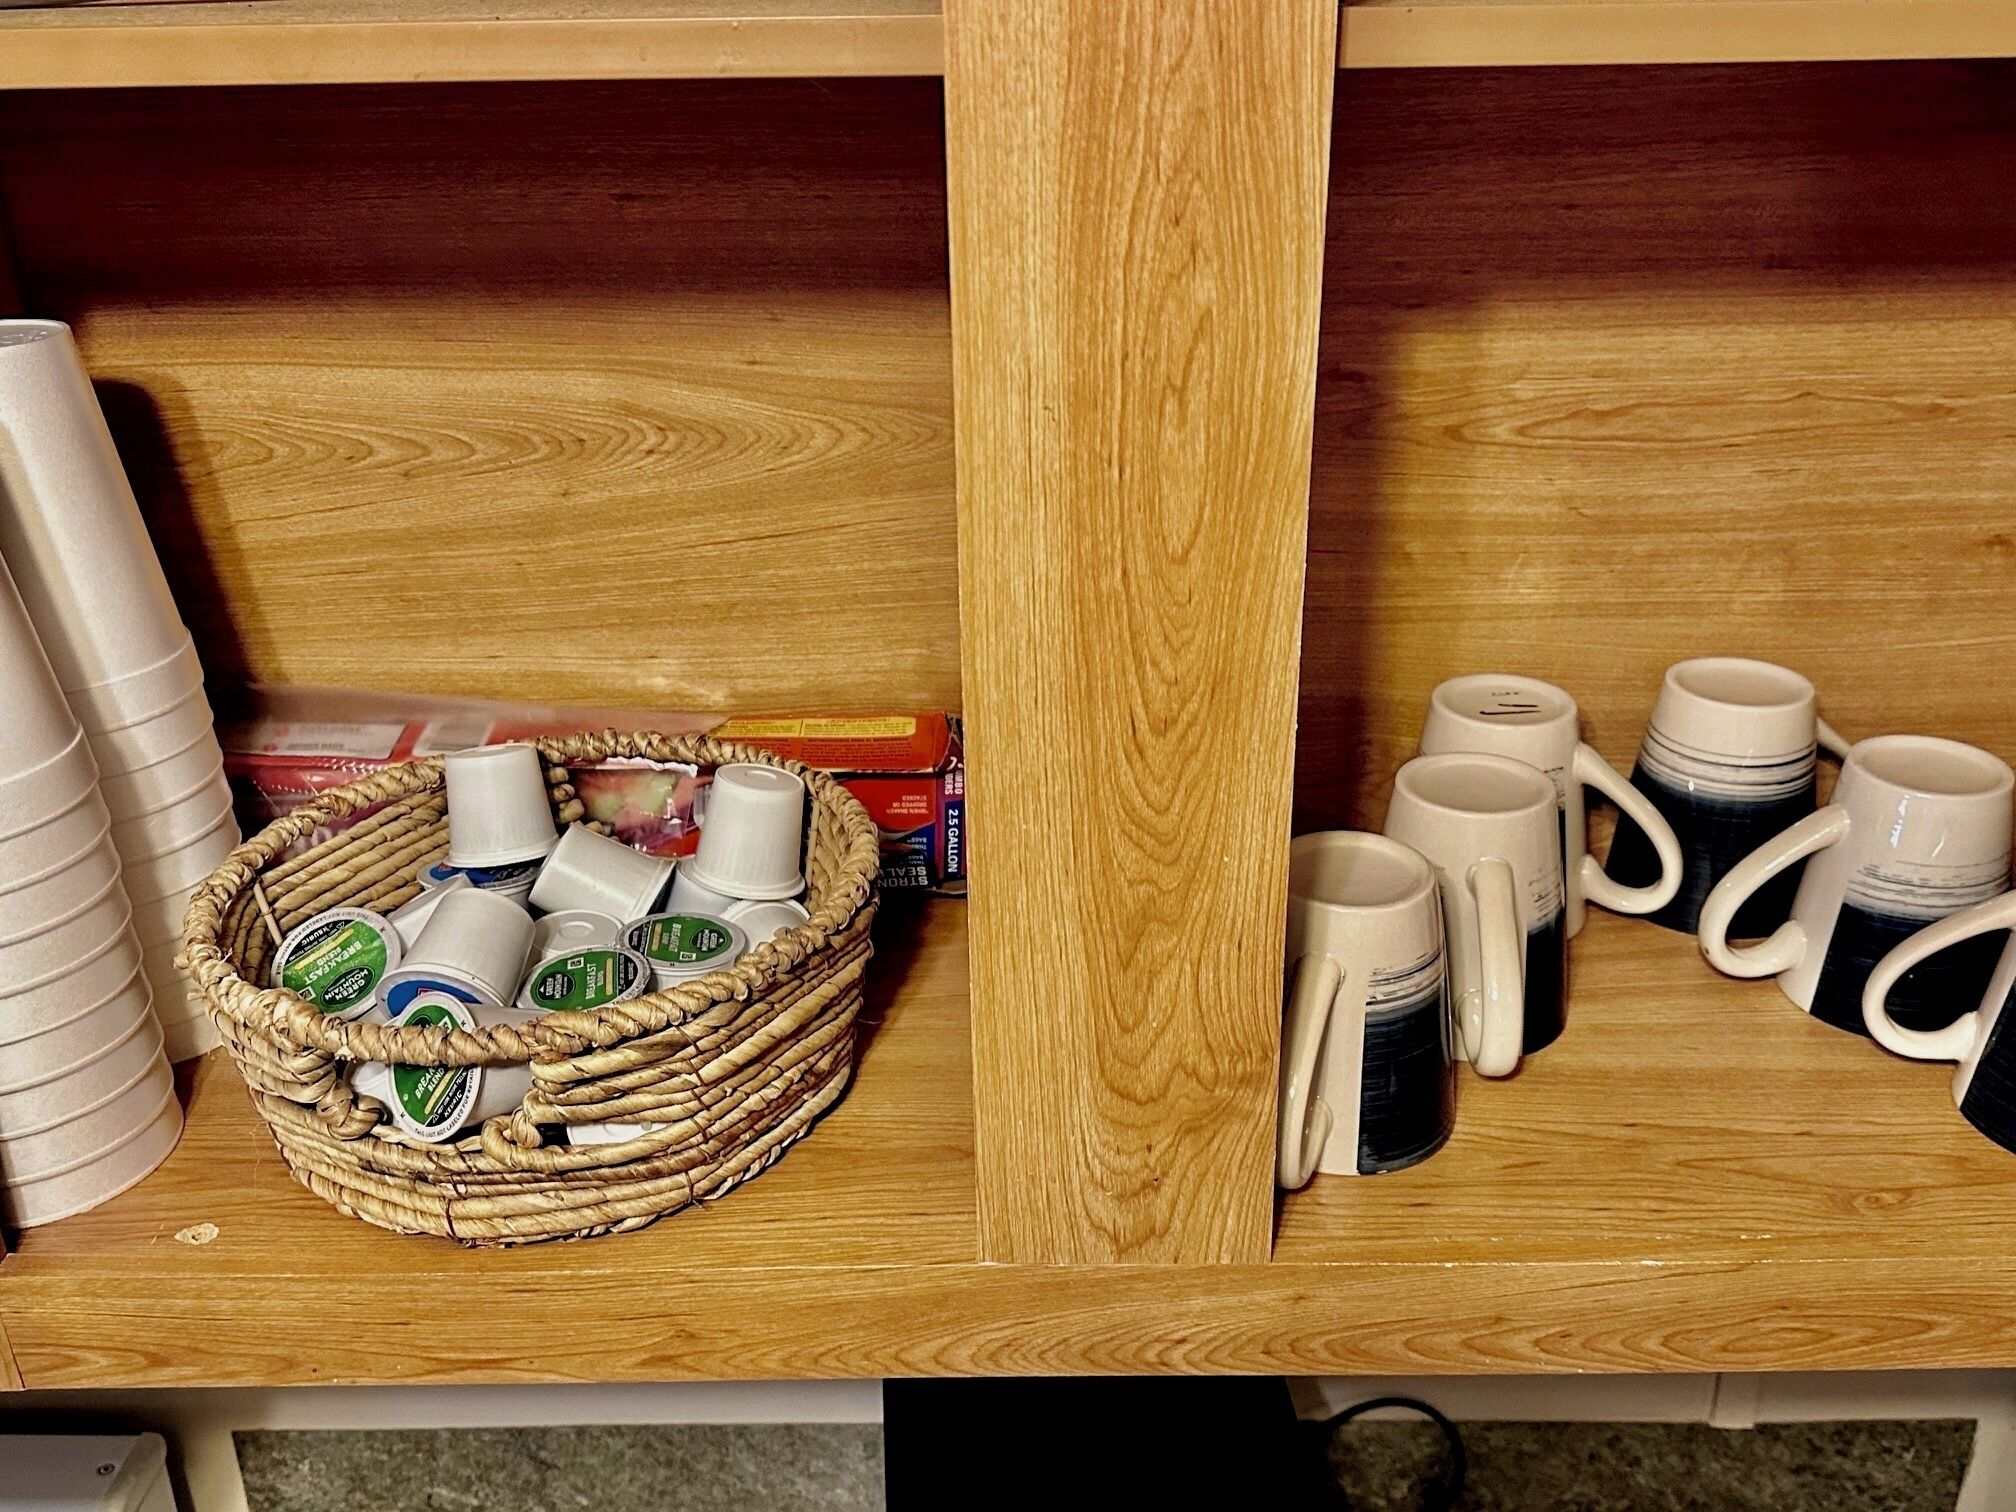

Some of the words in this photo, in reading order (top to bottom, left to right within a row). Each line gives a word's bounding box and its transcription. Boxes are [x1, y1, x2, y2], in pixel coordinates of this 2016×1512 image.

[954, 770, 963, 794] UMBO
[948, 809, 959, 825] 2.5
[948, 828, 959, 873] GALLON
[877, 876, 928, 887] STRON
[304, 941, 363, 985] BREAKFAST
[316, 946, 342, 966] BLEND
[325, 968, 369, 1000] MOUNTAIN
[335, 978, 366, 1001] GREEN
[415, 1067, 435, 1099] BREAK
[427, 1067, 445, 1092] BLEND
